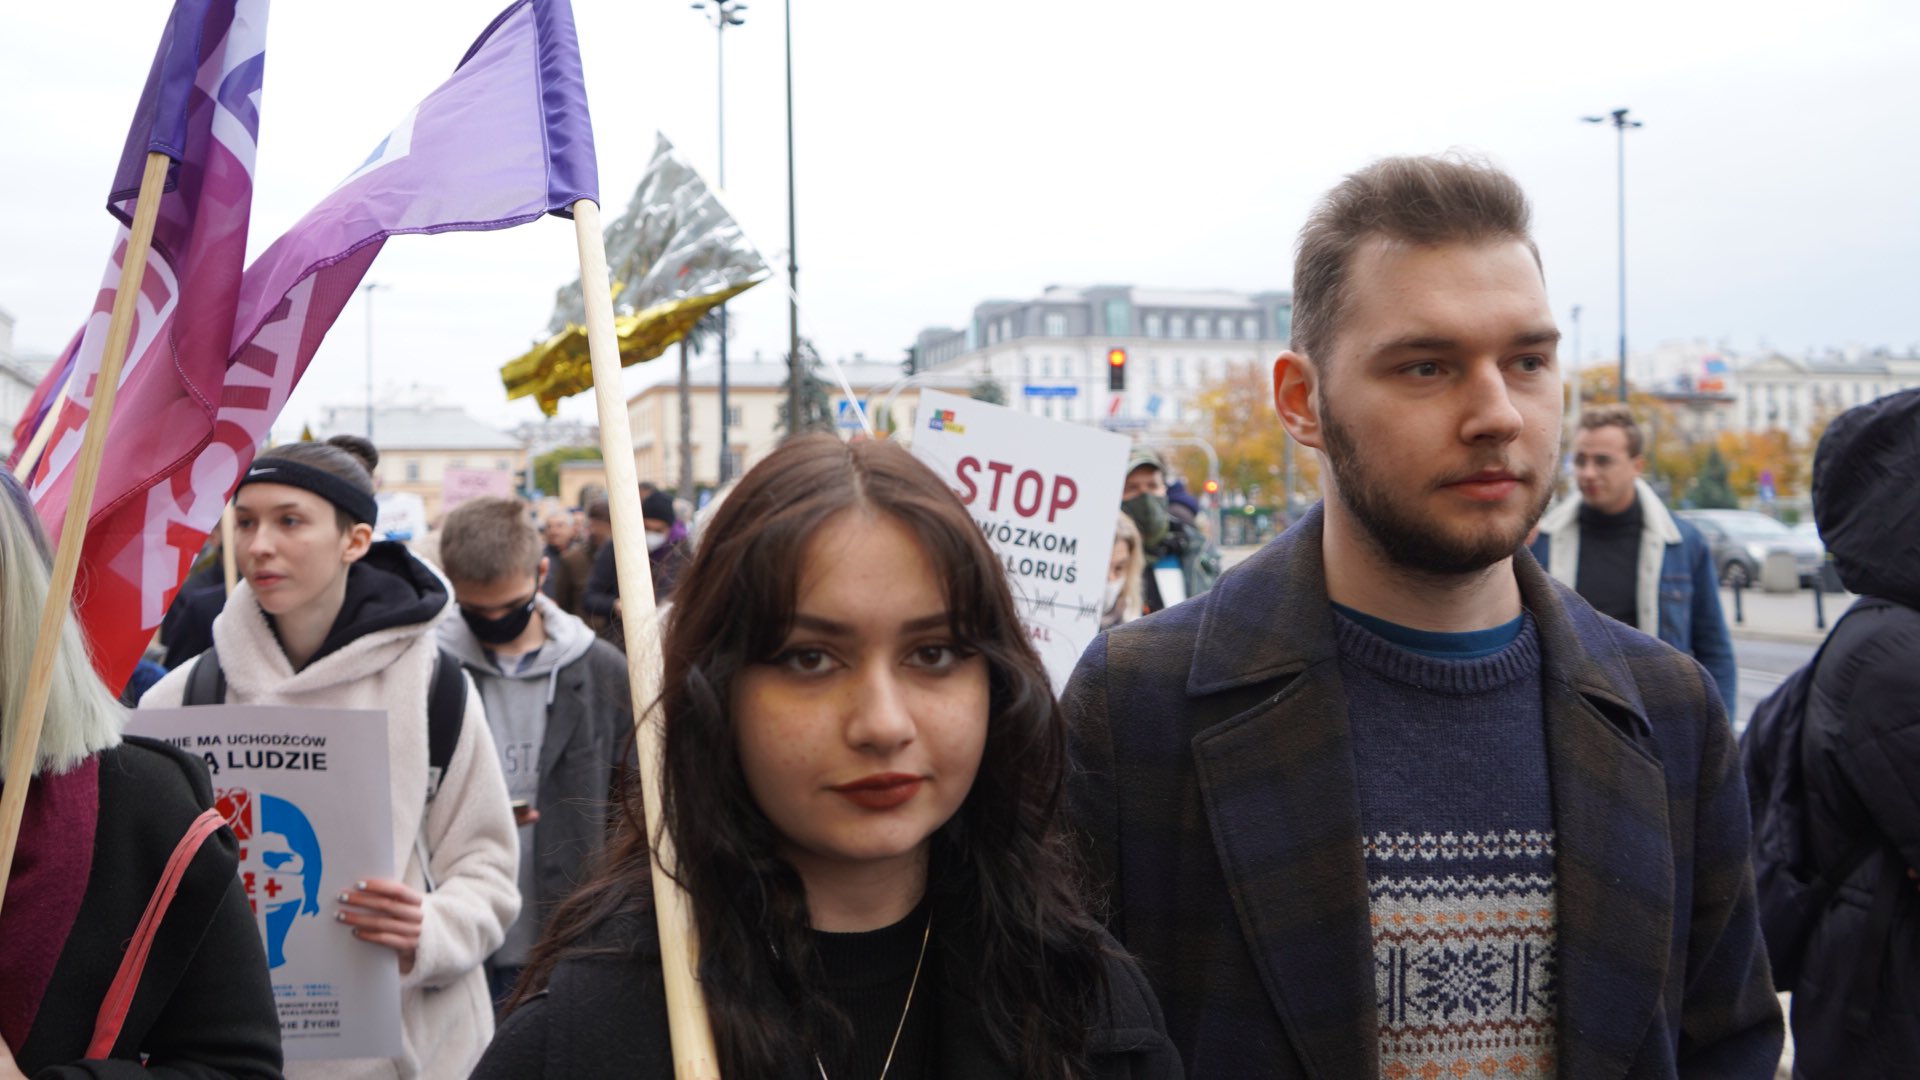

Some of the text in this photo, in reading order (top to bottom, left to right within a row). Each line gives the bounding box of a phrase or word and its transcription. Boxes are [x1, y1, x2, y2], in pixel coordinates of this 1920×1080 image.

[954, 456, 1078, 522] STOP
[1000, 553, 1077, 583] ŁORUŚ
[197, 735, 222, 746] MA
[227, 751, 328, 771] LUDZIE
[504, 741, 540, 773] ST
